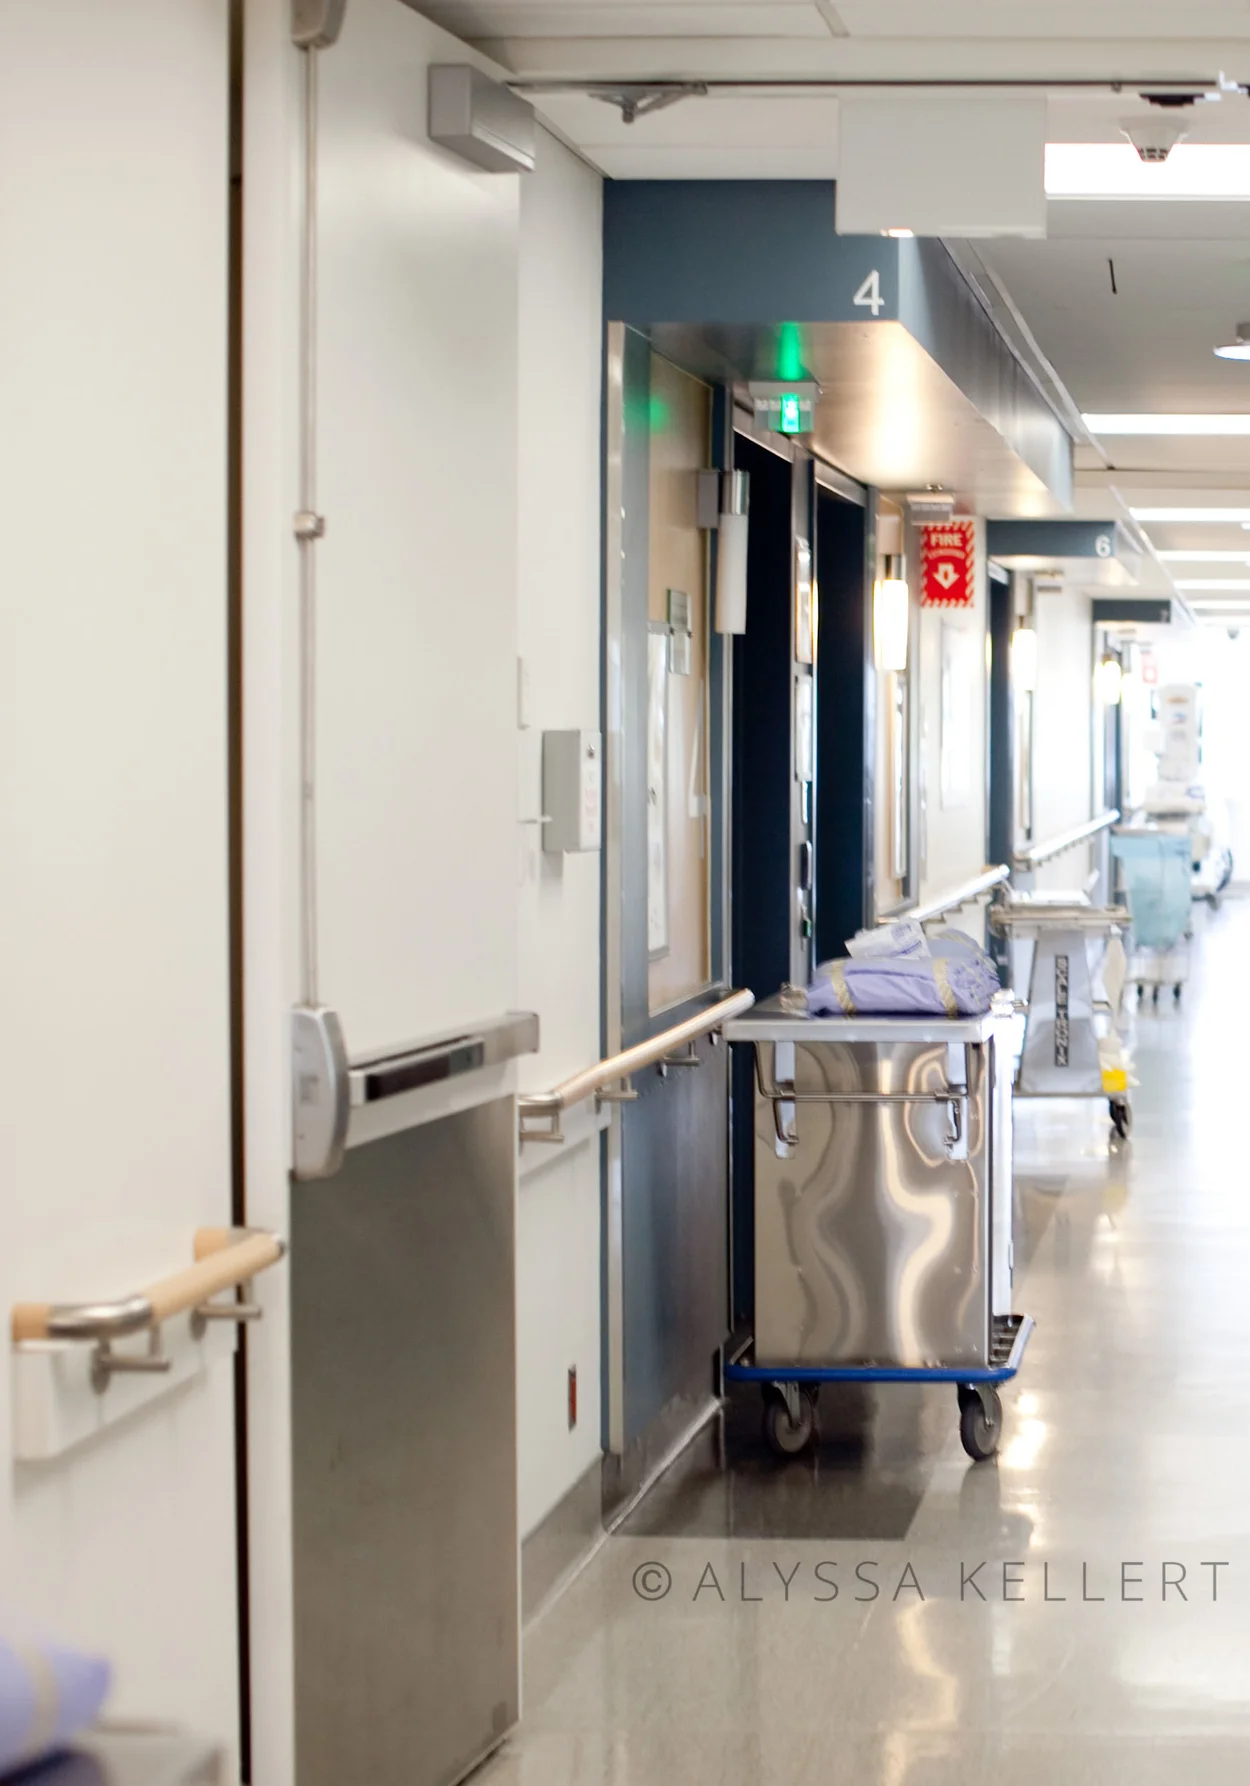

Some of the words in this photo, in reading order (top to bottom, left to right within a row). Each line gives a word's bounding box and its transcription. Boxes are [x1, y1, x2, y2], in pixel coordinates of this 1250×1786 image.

[853, 269, 885, 316] 4
[930, 533, 963, 547] FIRE
[1095, 534, 1111, 557] 6
